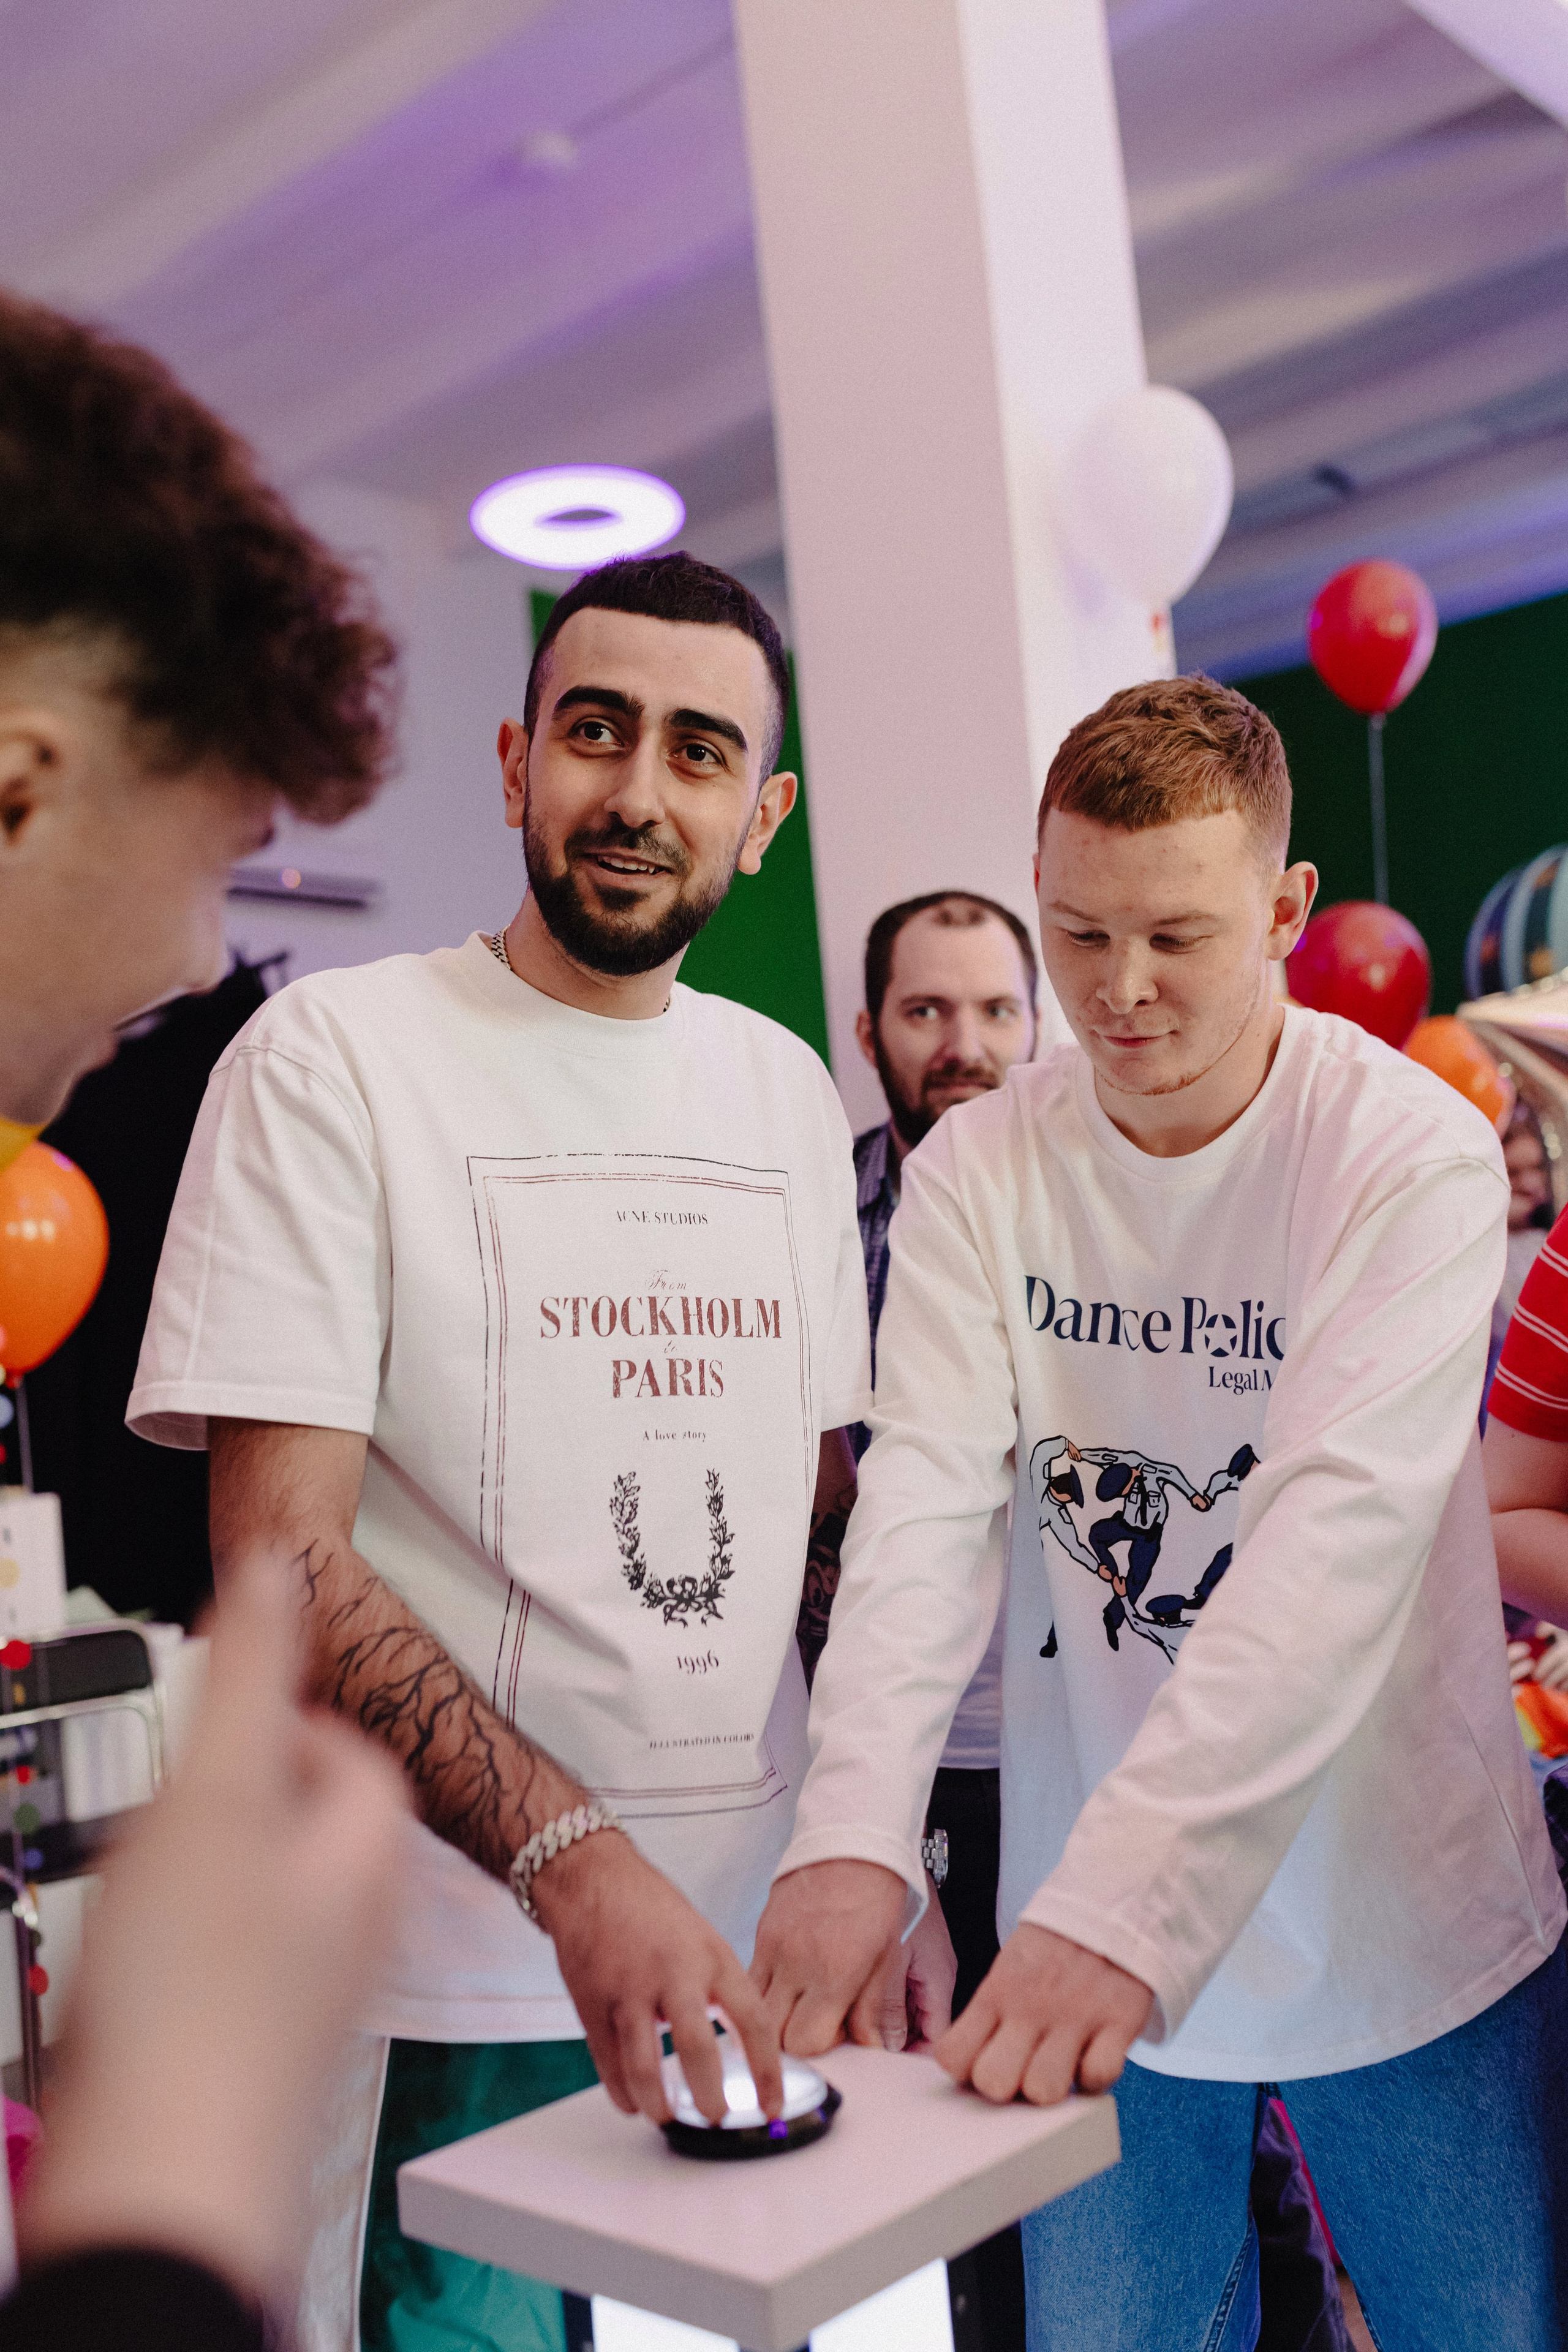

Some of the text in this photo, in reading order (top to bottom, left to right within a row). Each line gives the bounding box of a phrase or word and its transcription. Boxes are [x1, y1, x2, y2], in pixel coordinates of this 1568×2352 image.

[654, 1212, 708, 1226] STUDIOS
[540, 1295, 782, 1339] STOCKHOLM
[1025, 1275, 1286, 1361] Dance Polic
[611, 1358, 724, 1399] PARIS
[1208, 1366, 1259, 1395] Legal
[643, 1429, 706, 1442] A love story
[676, 1649, 719, 1675] 1996
